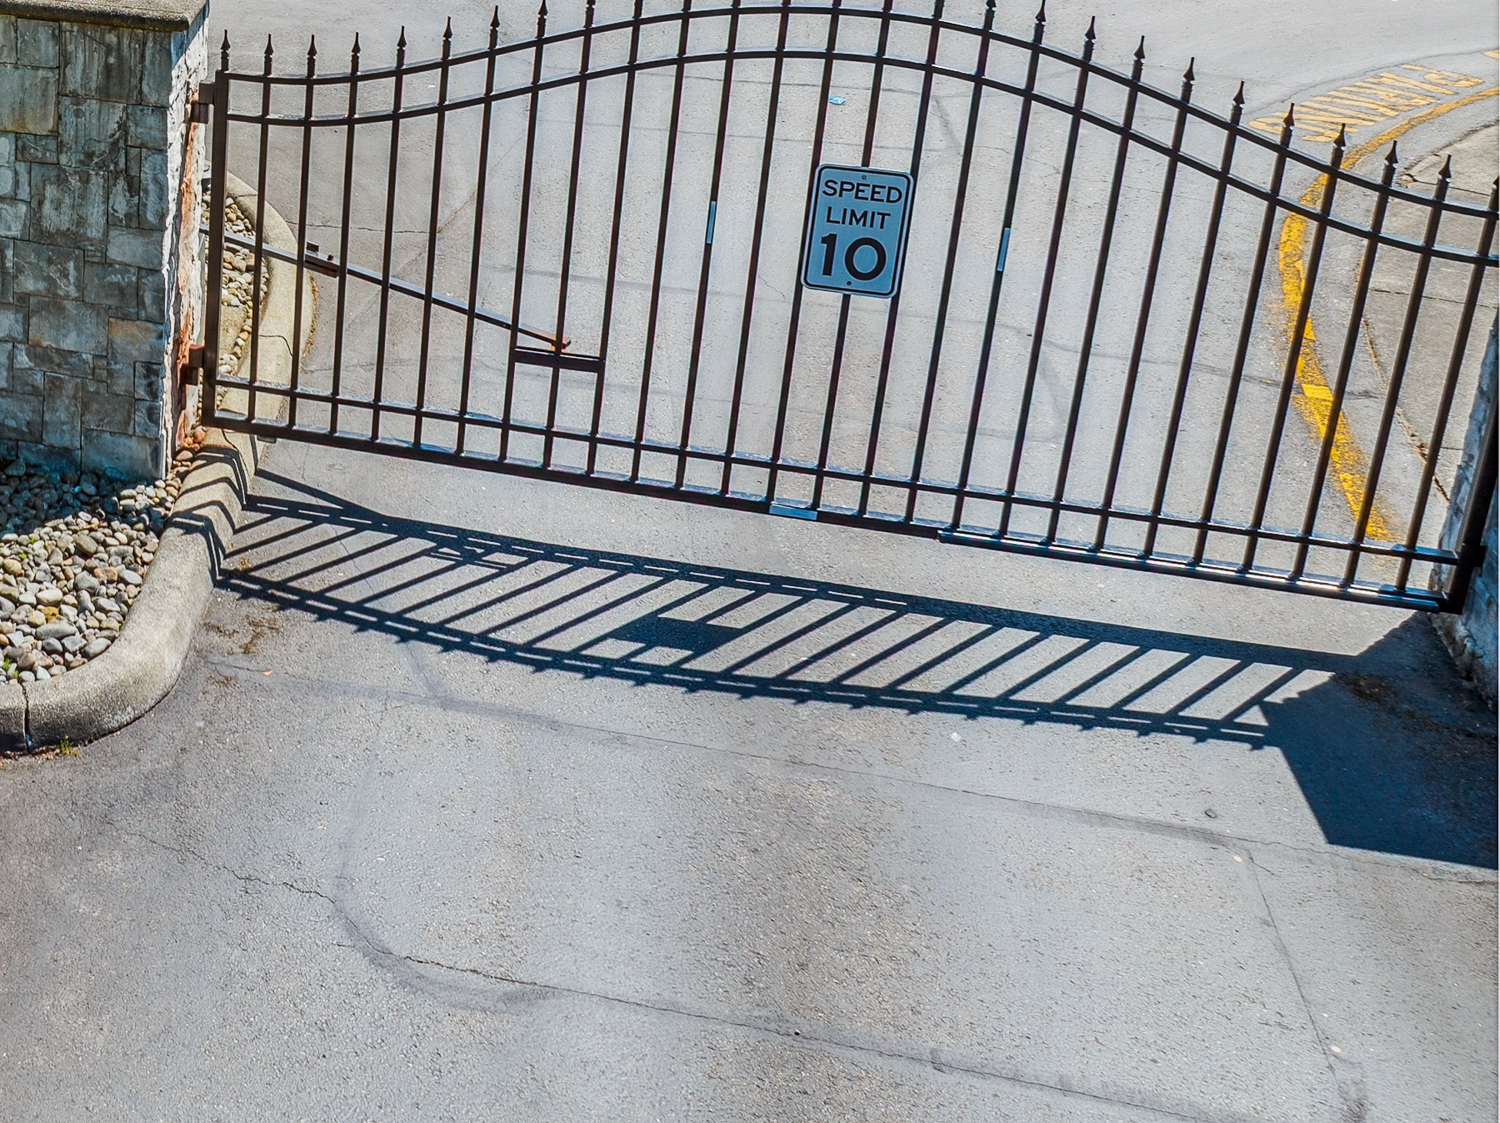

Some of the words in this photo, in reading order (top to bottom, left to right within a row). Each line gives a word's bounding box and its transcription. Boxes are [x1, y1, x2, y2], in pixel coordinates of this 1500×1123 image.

[1248, 63, 1485, 143] PARKING
[821, 179, 903, 204] SPEED
[825, 206, 892, 230] LIMIT
[820, 232, 887, 281] 10
